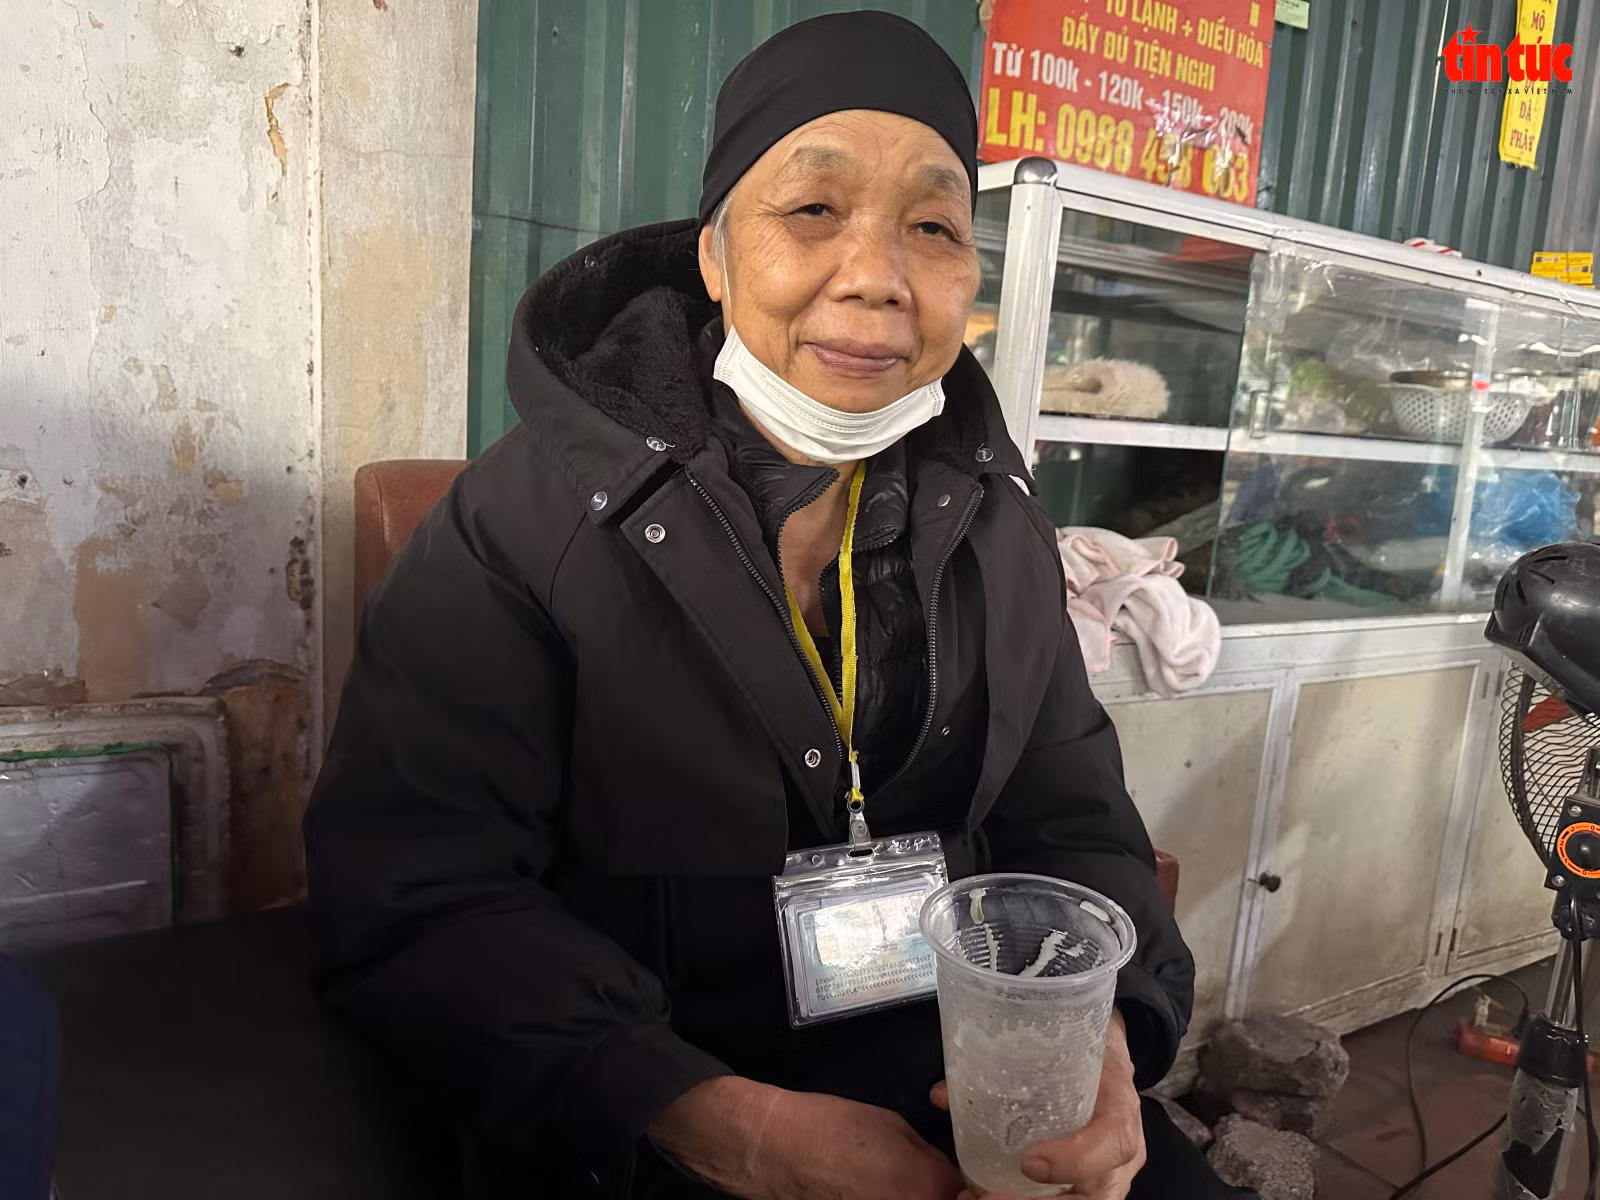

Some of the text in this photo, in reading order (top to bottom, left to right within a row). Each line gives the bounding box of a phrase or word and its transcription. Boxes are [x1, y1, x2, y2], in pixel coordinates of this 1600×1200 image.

[1131, 0, 1178, 35] LẠNH
[1182, 19, 1194, 38] +
[992, 41, 1024, 78] Từ
[1030, 49, 1079, 93] 100k
[1099, 71, 1144, 111] 120k
[1103, 26, 1129, 64] ĐỦ
[1133, 39, 1173, 79] TIỆN
[1174, 53, 1216, 91] NGHI
[986, 87, 1047, 152] LH:
[1056, 103, 1135, 174] 0988
